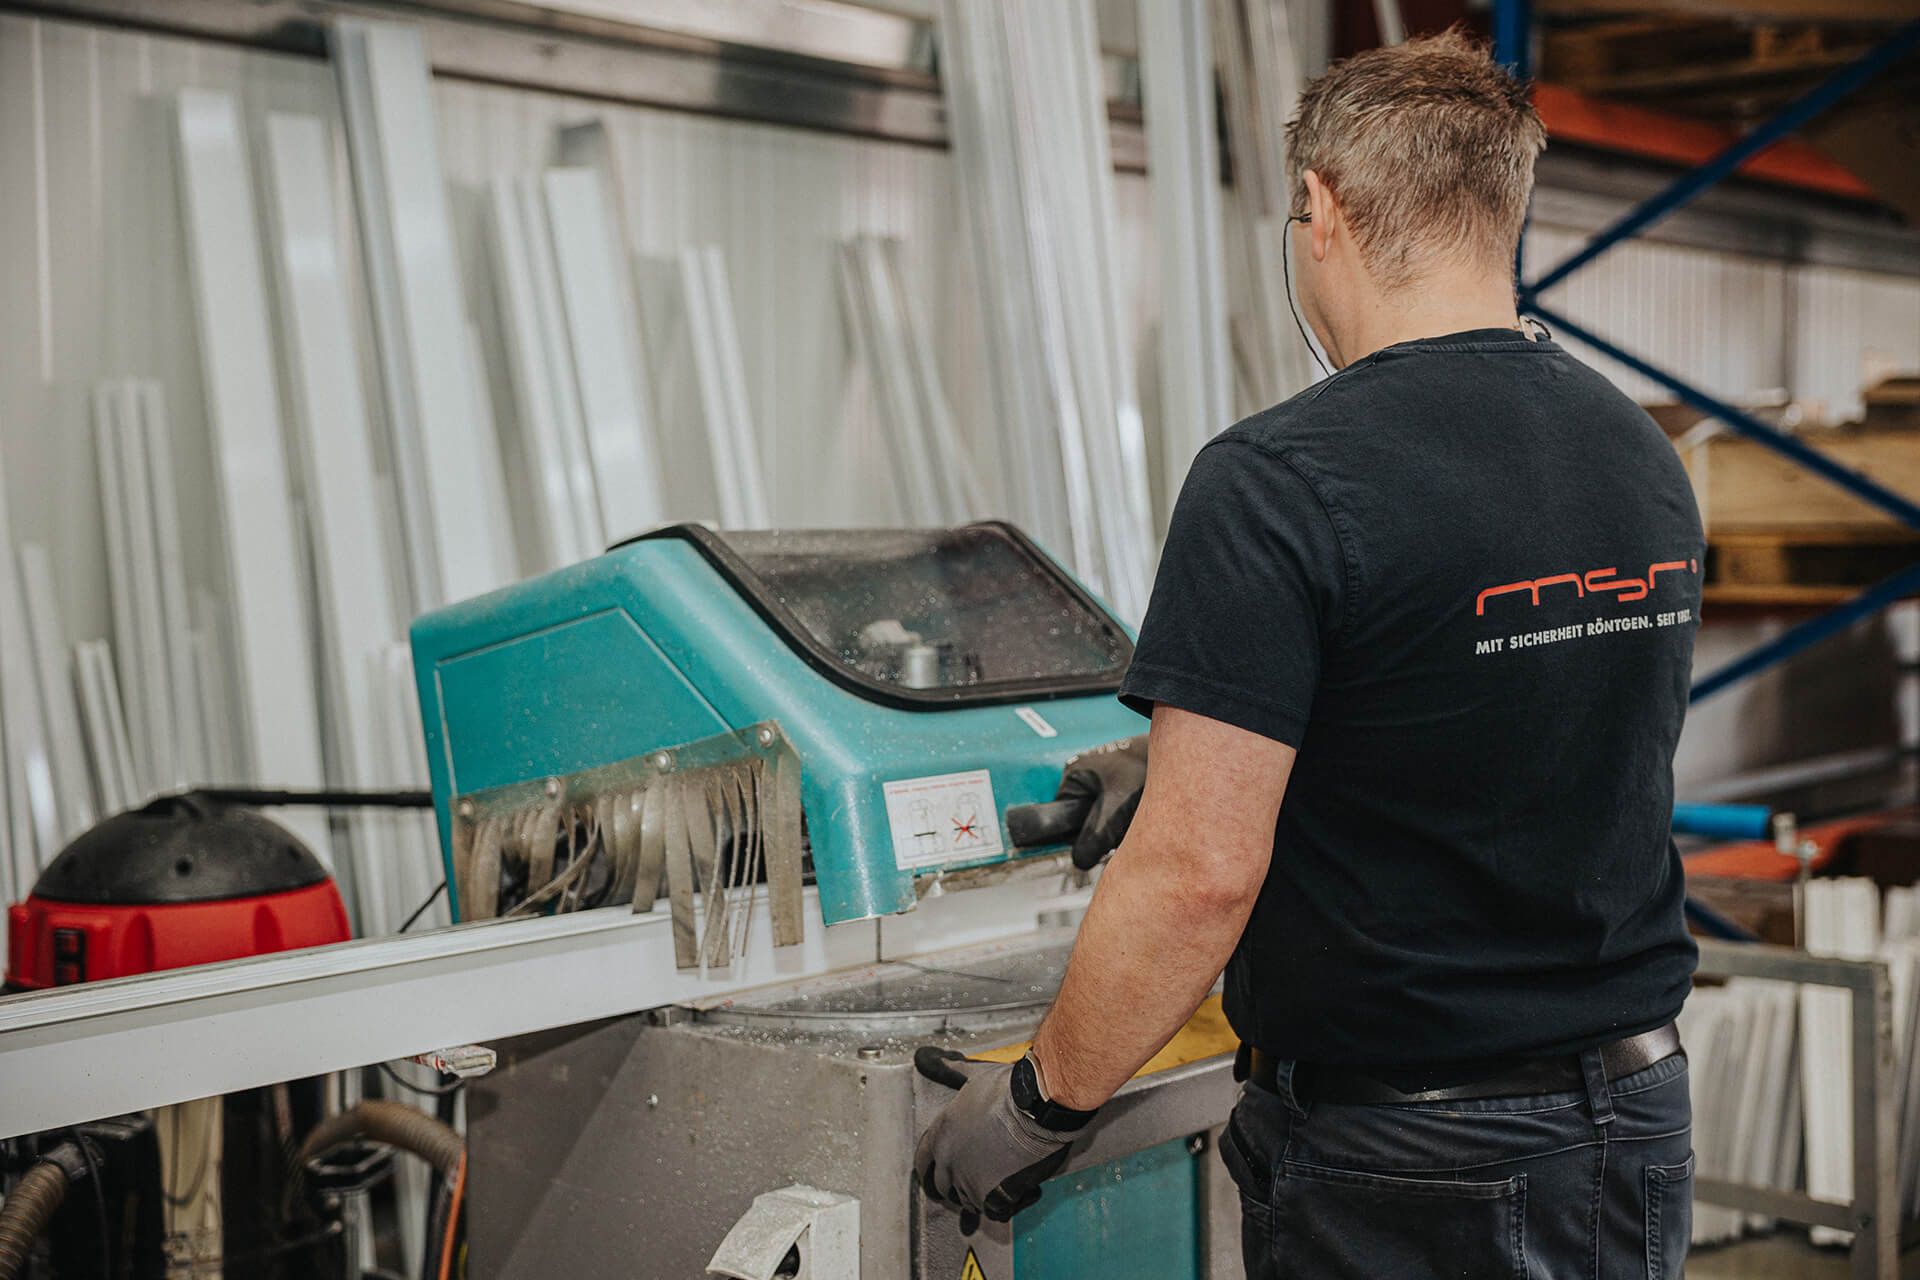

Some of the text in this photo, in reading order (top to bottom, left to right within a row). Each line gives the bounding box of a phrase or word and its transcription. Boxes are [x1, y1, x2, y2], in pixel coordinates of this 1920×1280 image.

[1475, 638, 1504, 655] MIT
[1509, 625, 1583, 649] SICHERHEIT
[1587, 616, 1653, 636] RÖNTGEN.
[1656, 612, 1676, 627] SEIT
